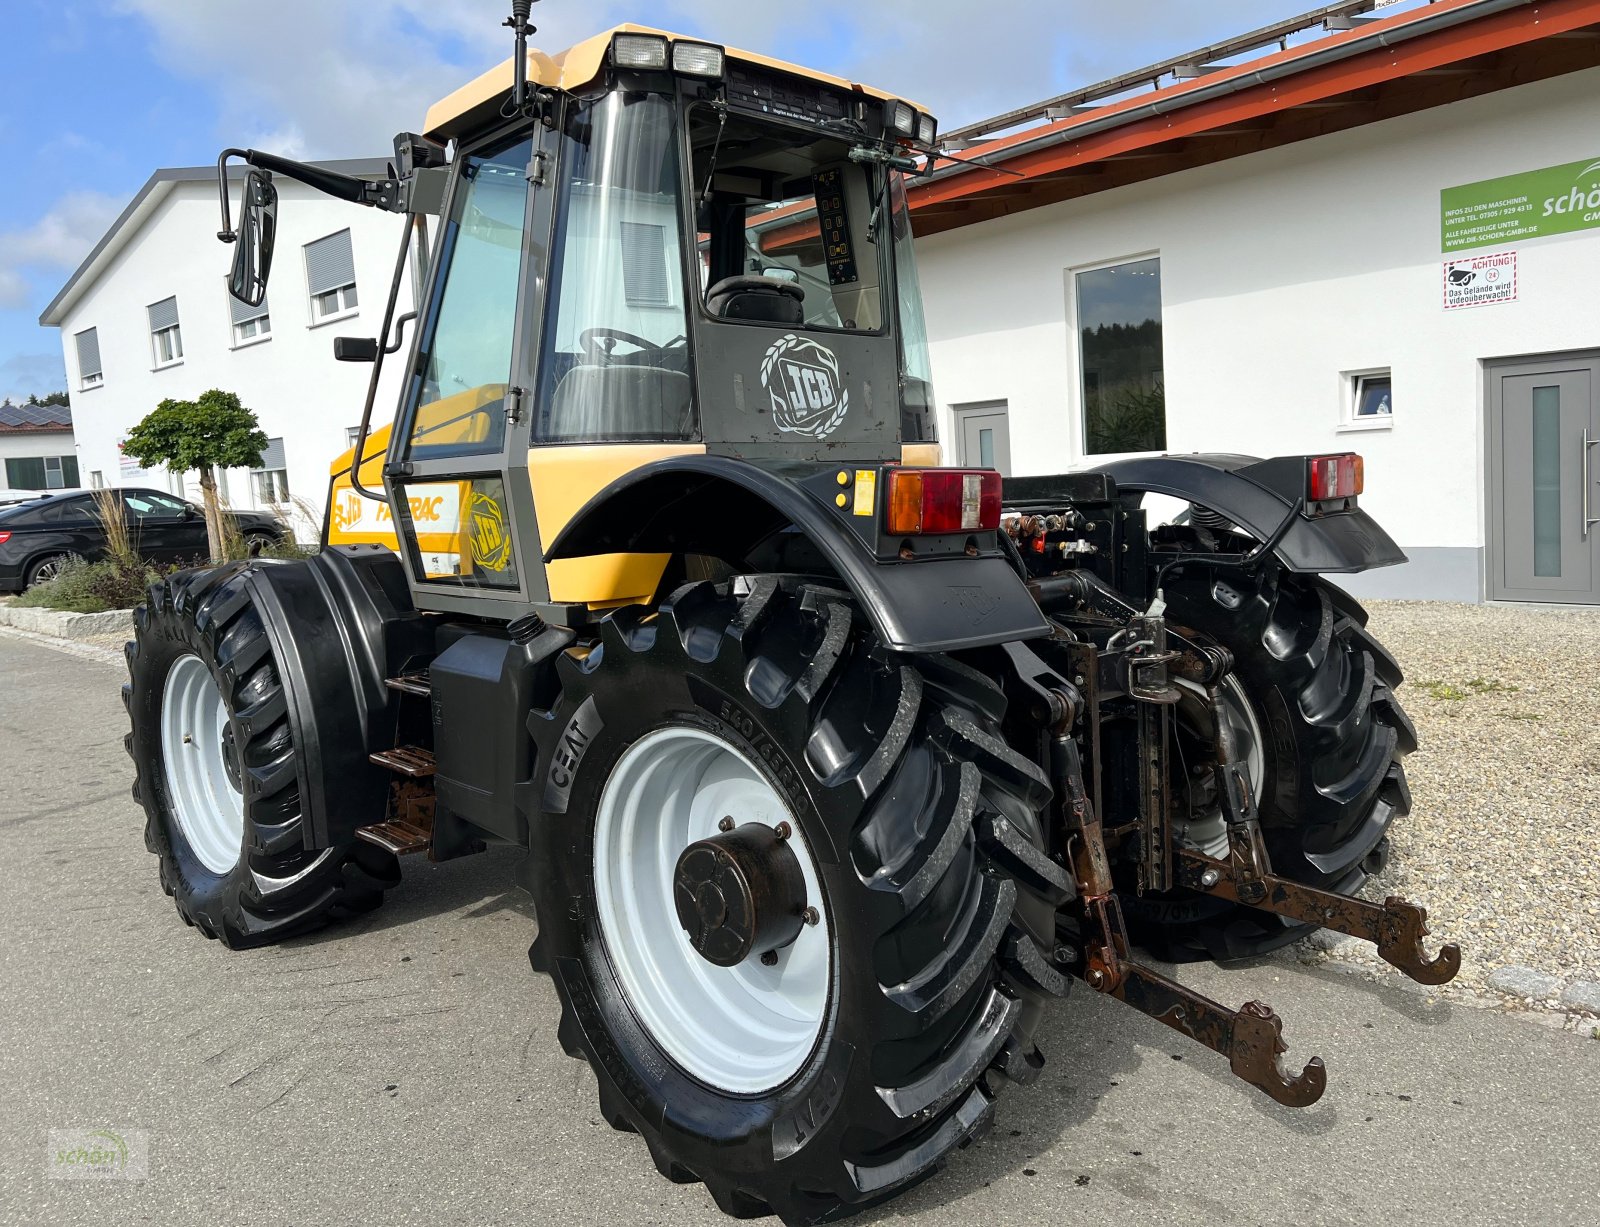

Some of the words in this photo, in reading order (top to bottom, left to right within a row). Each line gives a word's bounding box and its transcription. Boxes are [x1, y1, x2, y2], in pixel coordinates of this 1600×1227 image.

[1445, 208, 1464, 217] INFOS
[1464, 206, 1473, 214] ZU
[1474, 203, 1488, 212] DEN
[1488, 196, 1528, 209] MASCHINEN
[1445, 216, 1466, 226] UNTER
[1466, 213, 1479, 221] TEL.
[1479, 209, 1498, 219] 07305
[1503, 206, 1516, 215] 929
[1445, 229, 1460, 239] ALLE
[1460, 223, 1497, 236] FAHRZEUGE
[1497, 219, 1520, 230] UNTER
[1445, 225, 1538, 247] WWW.DIE-SCHOEN-GMBH.DE
[1472, 256, 1513, 270] ACHTUNG!
[1448, 289, 1462, 298] Das
[1463, 285, 1493, 296] Gelände
[1495, 281, 1511, 291] wird
[1449, 289, 1512, 305] videoüberwacht!
[787, 364, 833, 418] JCB
[473, 514, 503, 556] JCB
[552, 719, 590, 789] CEAT
